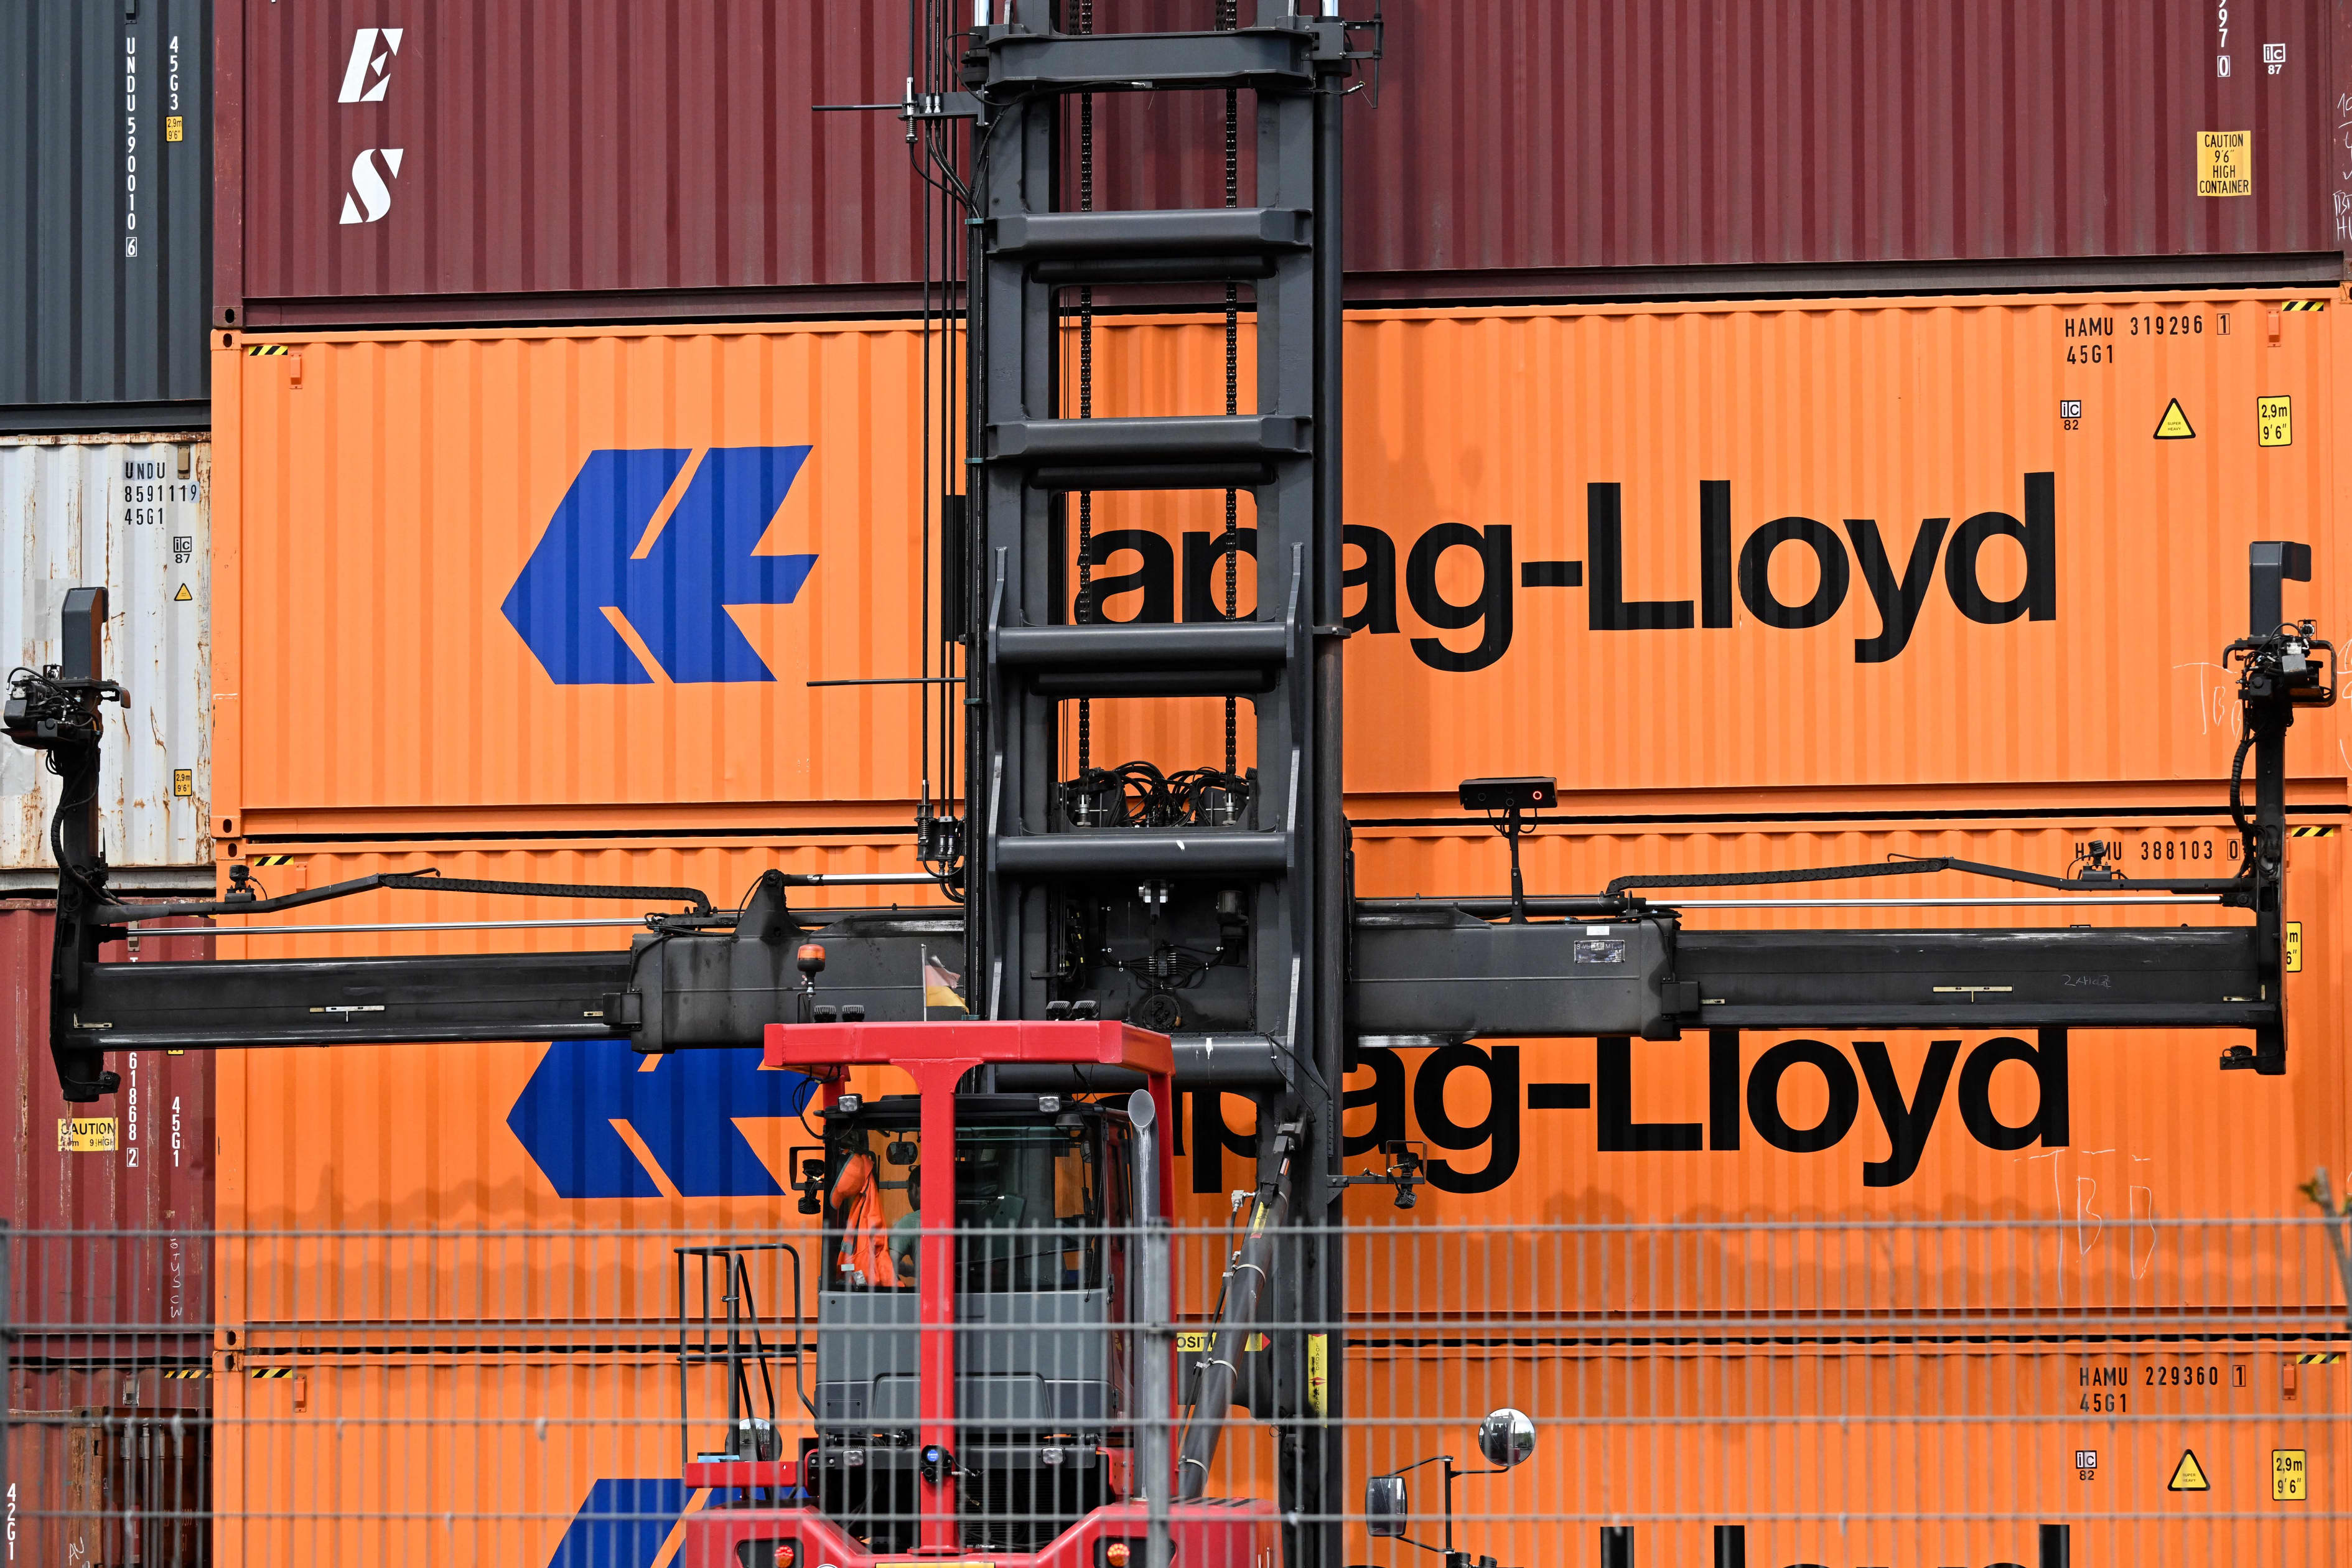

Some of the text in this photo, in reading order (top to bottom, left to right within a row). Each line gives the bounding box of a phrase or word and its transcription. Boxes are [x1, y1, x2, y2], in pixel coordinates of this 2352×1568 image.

[169, 35, 179, 111] 45G3
[2218, 56, 2229, 76] 0
[2267, 64, 2282, 75] 87
[126, 37, 136, 256] UNDU 590010 6
[2205, 134, 2244, 148] CAUTION
[2213, 165, 2236, 179] HIGH
[2199, 179, 2249, 194] CONTAINER
[2065, 314, 2229, 337] HAMU 319296 1
[2066, 344, 2113, 365] 45G1
[2063, 419, 2079, 431] 82
[124, 462, 166, 480] UNDU
[124, 484, 197, 503] 8591119
[124, 507, 164, 525] 45G1
[175, 553, 190, 564] 87
[2076, 840, 2239, 861] HMU 388103 0
[1174, 1028, 2070, 1194] pag-Lloyd
[62, 1122, 115, 1136] CAUTION
[172, 1096, 180, 1167] 45G1
[127, 1148, 138, 1167] 2
[2079, 1366, 2245, 1386] HAMU 229360 1
[2079, 1393, 2126, 1412] 45G1
[2079, 1470, 2094, 1480] 82
[7, 1483, 17, 1561] 42G1
